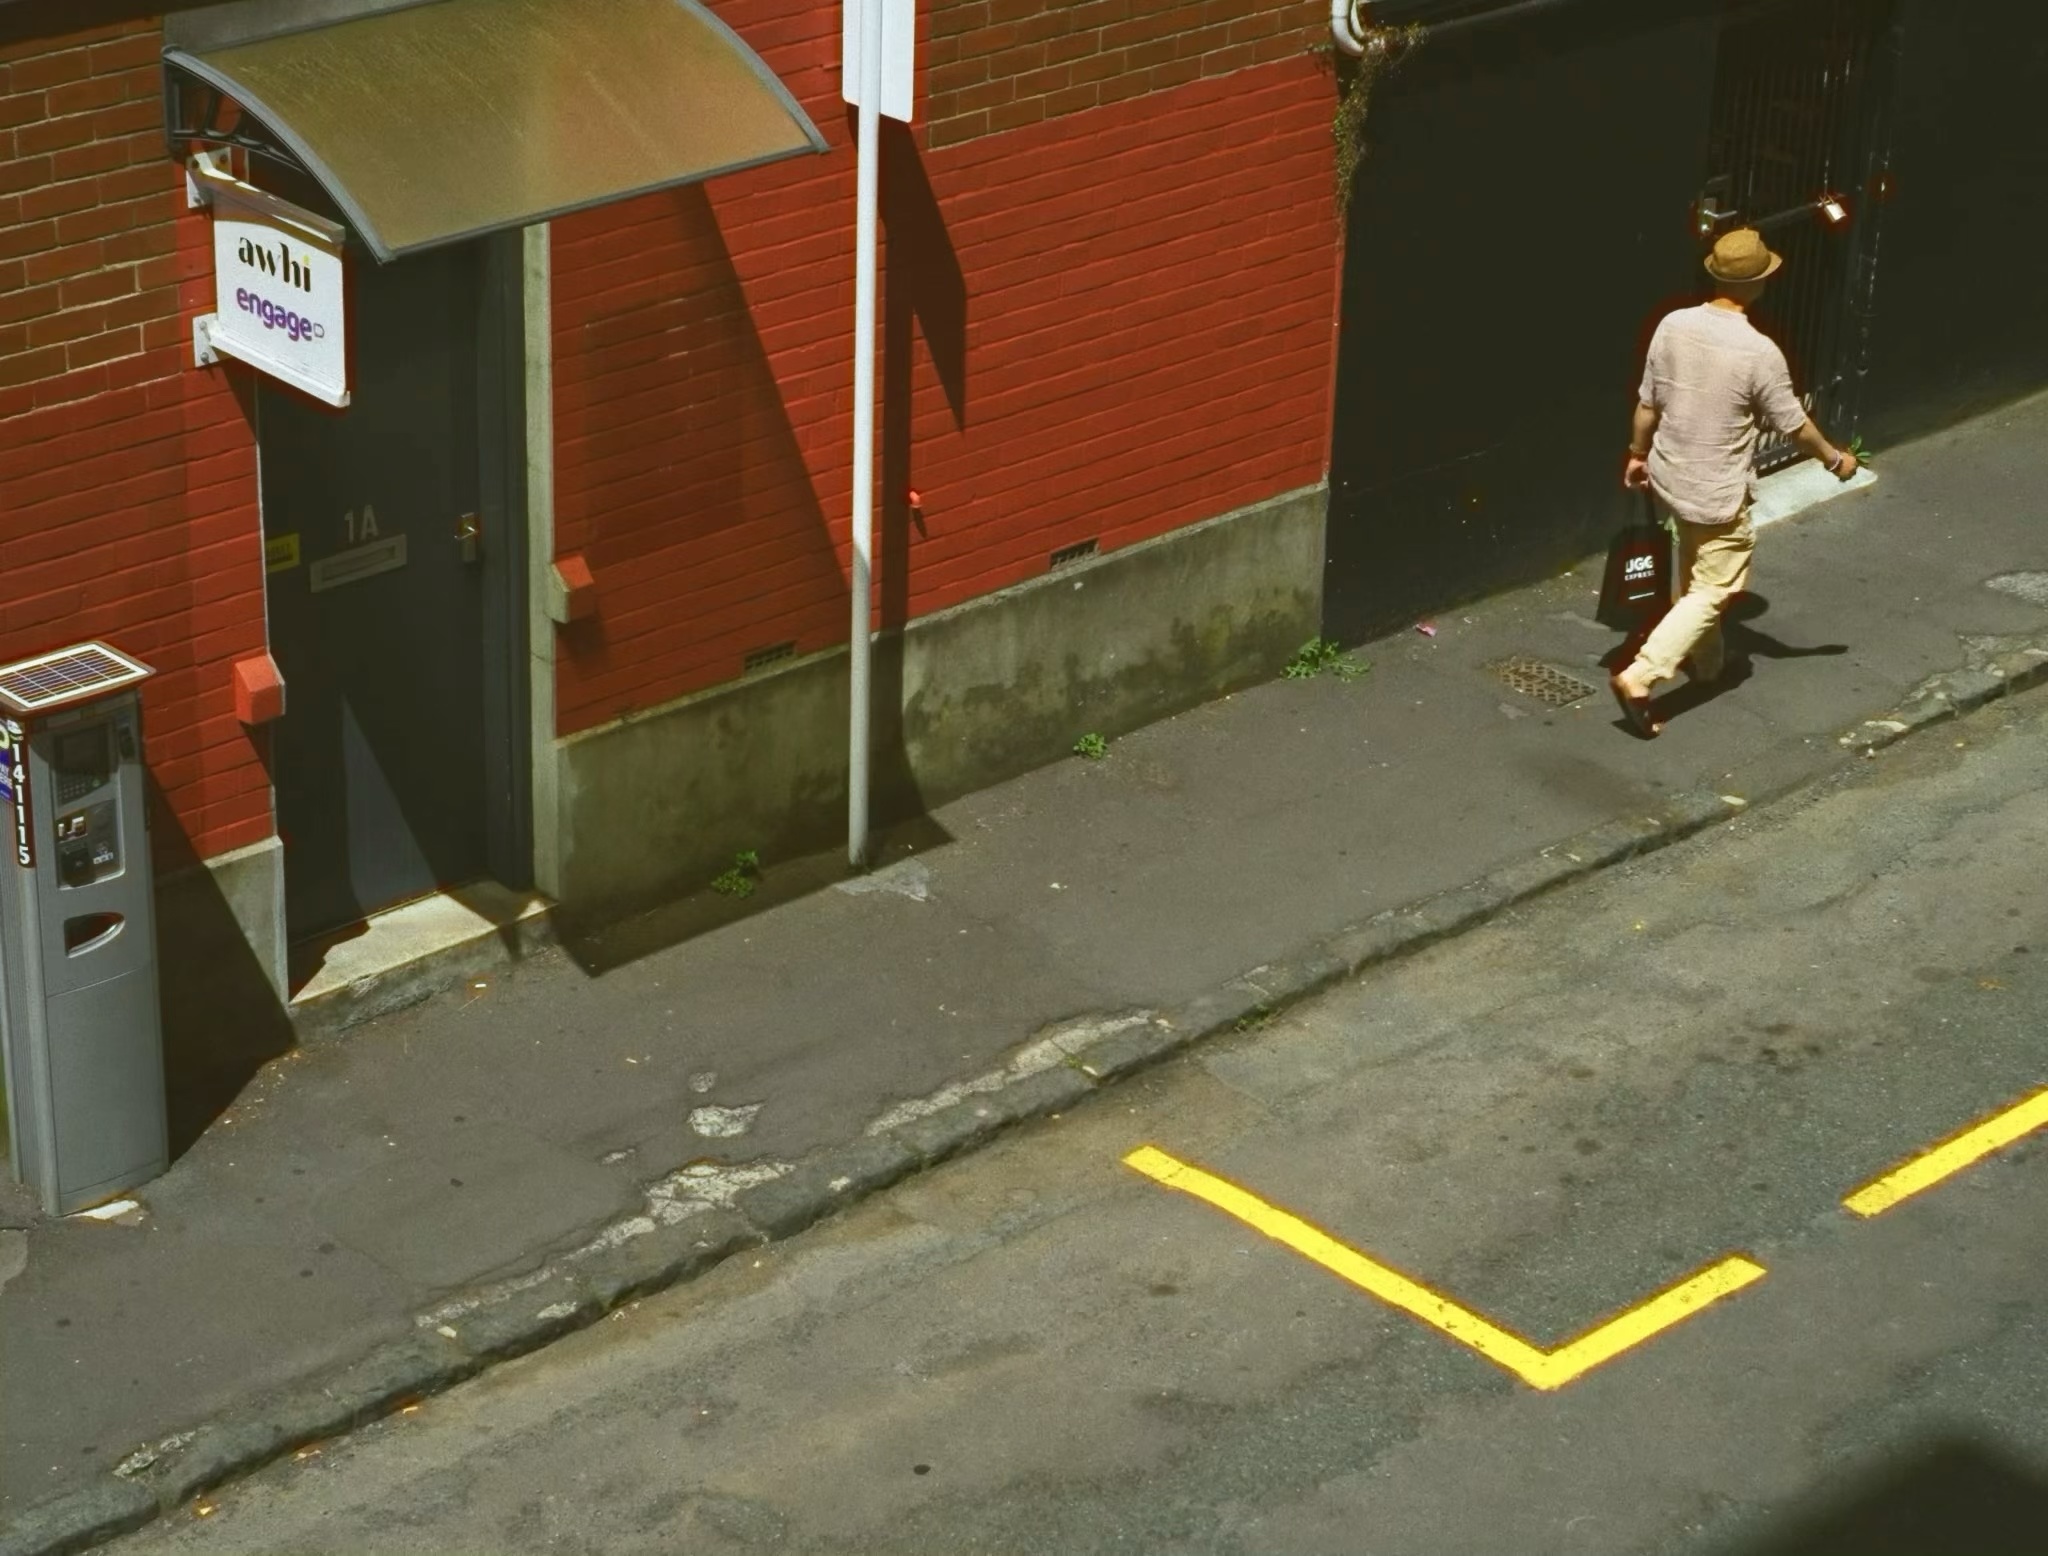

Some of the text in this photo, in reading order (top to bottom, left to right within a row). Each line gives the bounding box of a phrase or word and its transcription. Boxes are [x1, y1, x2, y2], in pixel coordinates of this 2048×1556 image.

[238, 237, 311, 293] awhi
[236, 287, 313, 342] engage
[344, 504, 379, 544] 1A
